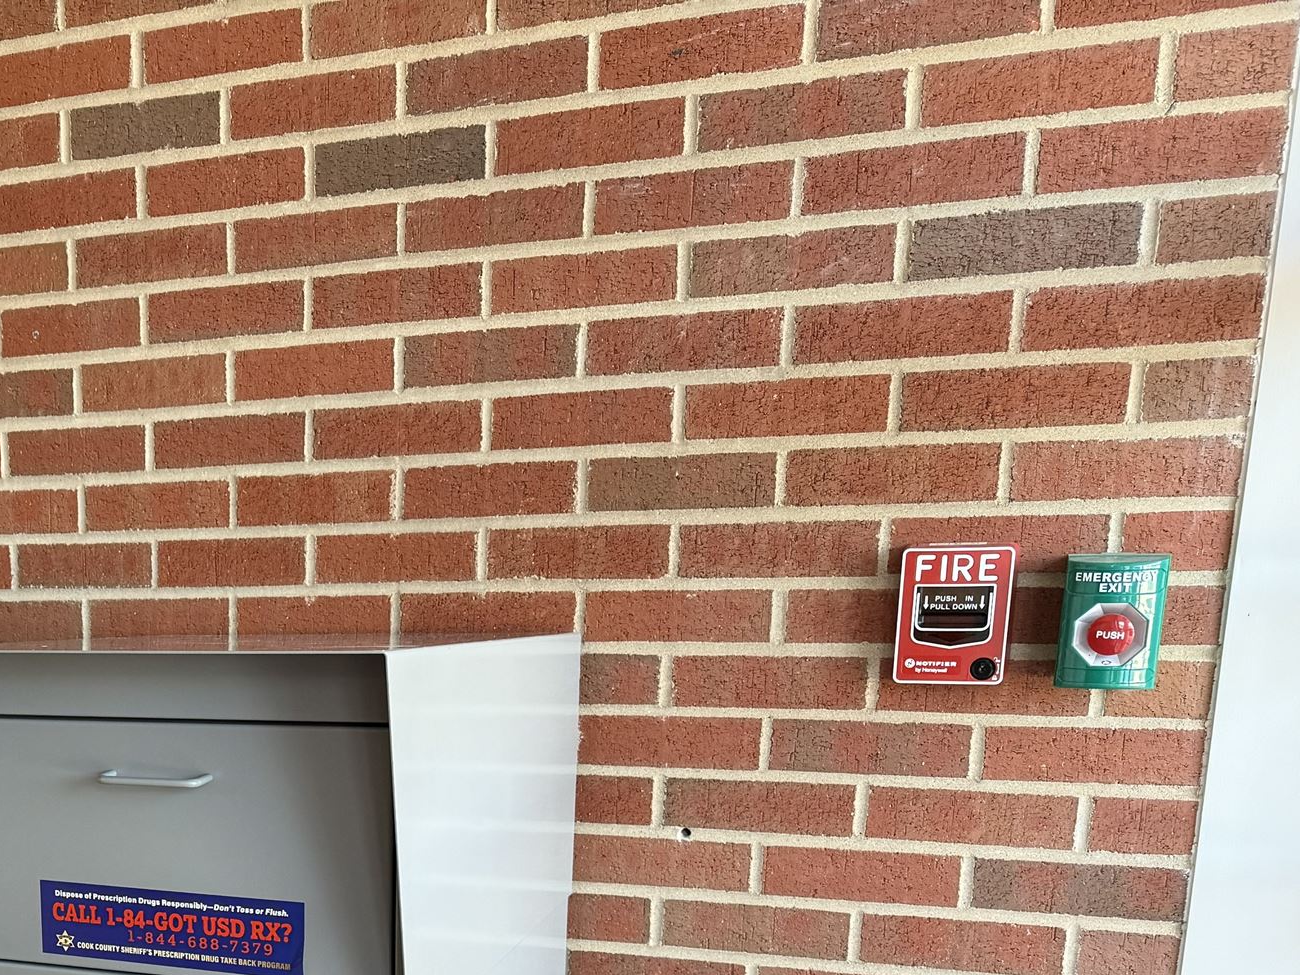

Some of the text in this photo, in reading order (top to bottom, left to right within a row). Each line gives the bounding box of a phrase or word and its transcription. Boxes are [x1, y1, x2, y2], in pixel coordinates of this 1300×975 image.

[915, 553, 1001, 582] FIRE
[1075, 571, 1158, 583] EMERGENCY
[1098, 582, 1132, 593] EXIT
[934, 594, 974, 602] PUSH IN
[1095, 630, 1125, 640] PUSH
[915, 660, 958, 668] NOTIFIER
[54, 889, 83, 900] Dispose
[83, 891, 91, 899] of
[92, 892, 137, 905] Prescription
[137, 897, 160, 907] Drugs
[161, 898, 234, 914] Responsibly—Don't
[235, 905, 253, 914] Toss
[264, 907, 288, 917] Flush.
[52, 901, 292, 943] CALL 1-84-GOT USD RX?
[127, 929, 273, 956] 1-844-688-7379
[76, 941, 290, 970] COOK COUNTY SHERIFF'S PRESCRIPTION DRUG TAKE BACK PROGRAM
